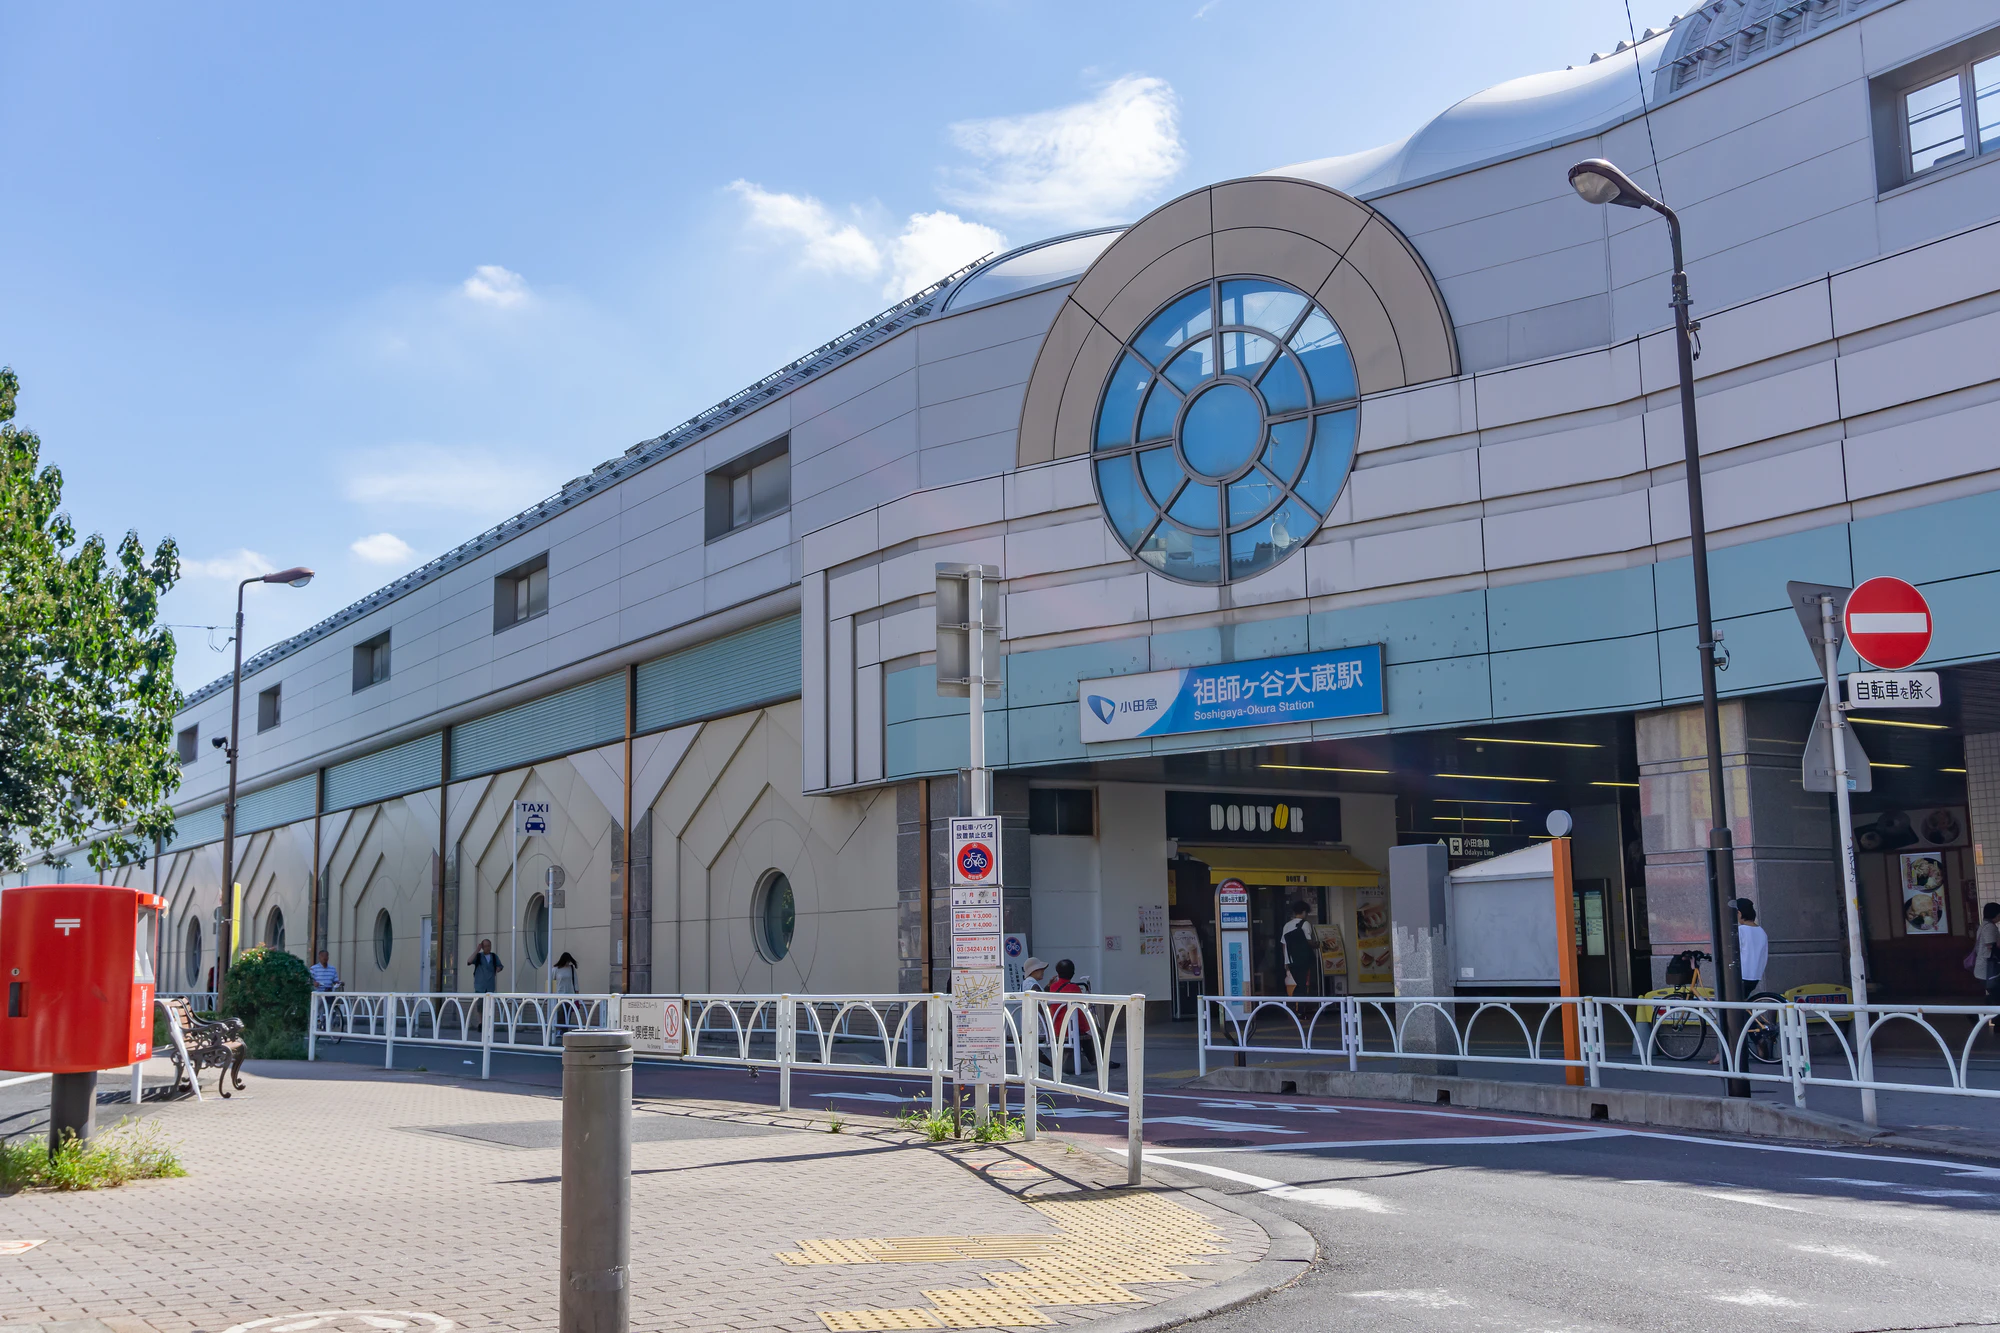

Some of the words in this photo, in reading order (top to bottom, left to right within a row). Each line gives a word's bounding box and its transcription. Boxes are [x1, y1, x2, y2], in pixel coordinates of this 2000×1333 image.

[1856, 679, 1933, 700] 自転車を除く
[1119, 698, 1158, 714] 小田急
[1193, 703, 1277, 722] Soshigaya-Okura
[1279, 699, 1314, 712] Station
[521, 803, 549, 813] TAXI
[1210, 803, 1304, 833] DOUTOR
[1464, 838, 1490, 848] 小田急線
[1464, 849, 1482, 857] Odakyu
